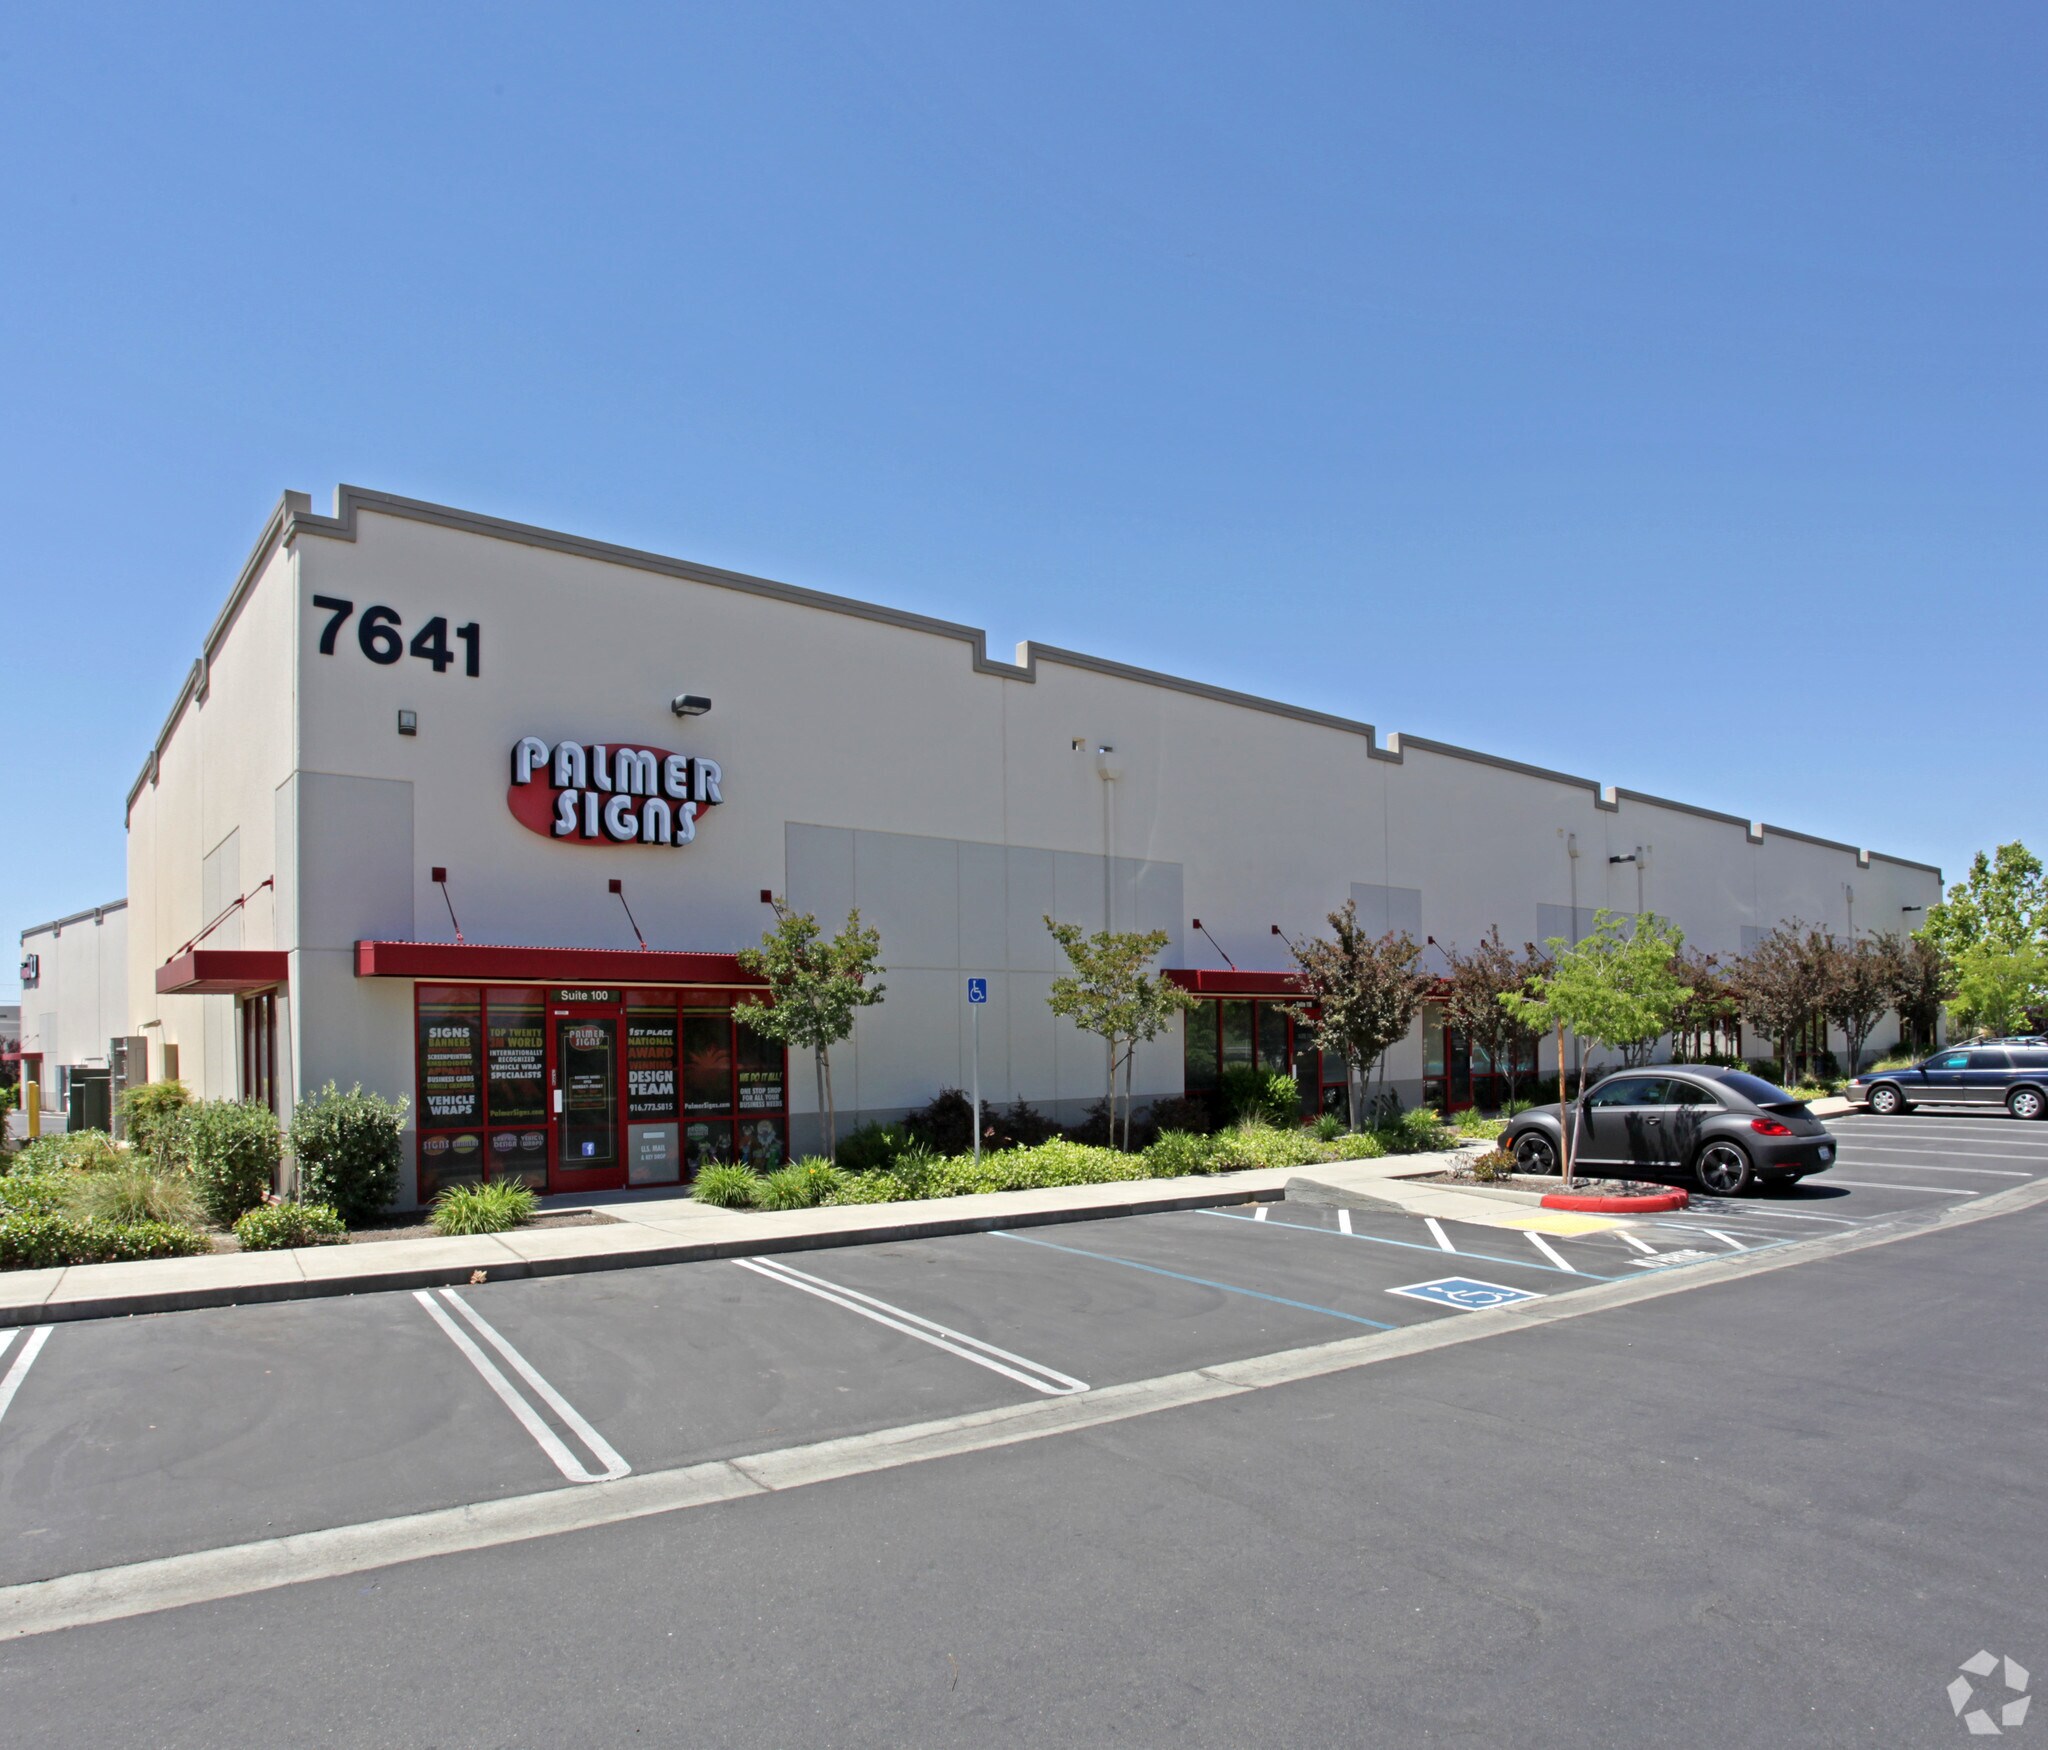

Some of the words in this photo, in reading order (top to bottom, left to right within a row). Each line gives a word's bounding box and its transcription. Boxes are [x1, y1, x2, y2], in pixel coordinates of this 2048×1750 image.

[313, 595, 480, 677] 7641
[511, 735, 724, 805] PALMER
[552, 788, 698, 847] SIGNS
[561, 990, 587, 1000] Suite
[591, 990, 608, 1000] 100
[429, 1028, 470, 1038] SIGNS
[490, 1028, 506, 1036] TOP
[509, 1028, 542, 1036] TWENTY
[569, 1030, 604, 1038] PALMER
[428, 1038, 470, 1047] BANNERS
[508, 1038, 543, 1048] WORLD
[575, 1038, 600, 1046] SIGNS
[628, 1038, 674, 1046] NATIONAL
[628, 1047, 673, 1058] AWARD
[628, 1070, 673, 1083] DESIGN
[628, 1083, 674, 1095] TEAM
[427, 1095, 475, 1105] VEHICLE
[431, 1105, 472, 1115] WRAPS
[630, 1103, 673, 1112] 916.773.5815
[490, 1109, 544, 1117] PalmerSigns.com
[424, 1140, 449, 1150] SIGNS
